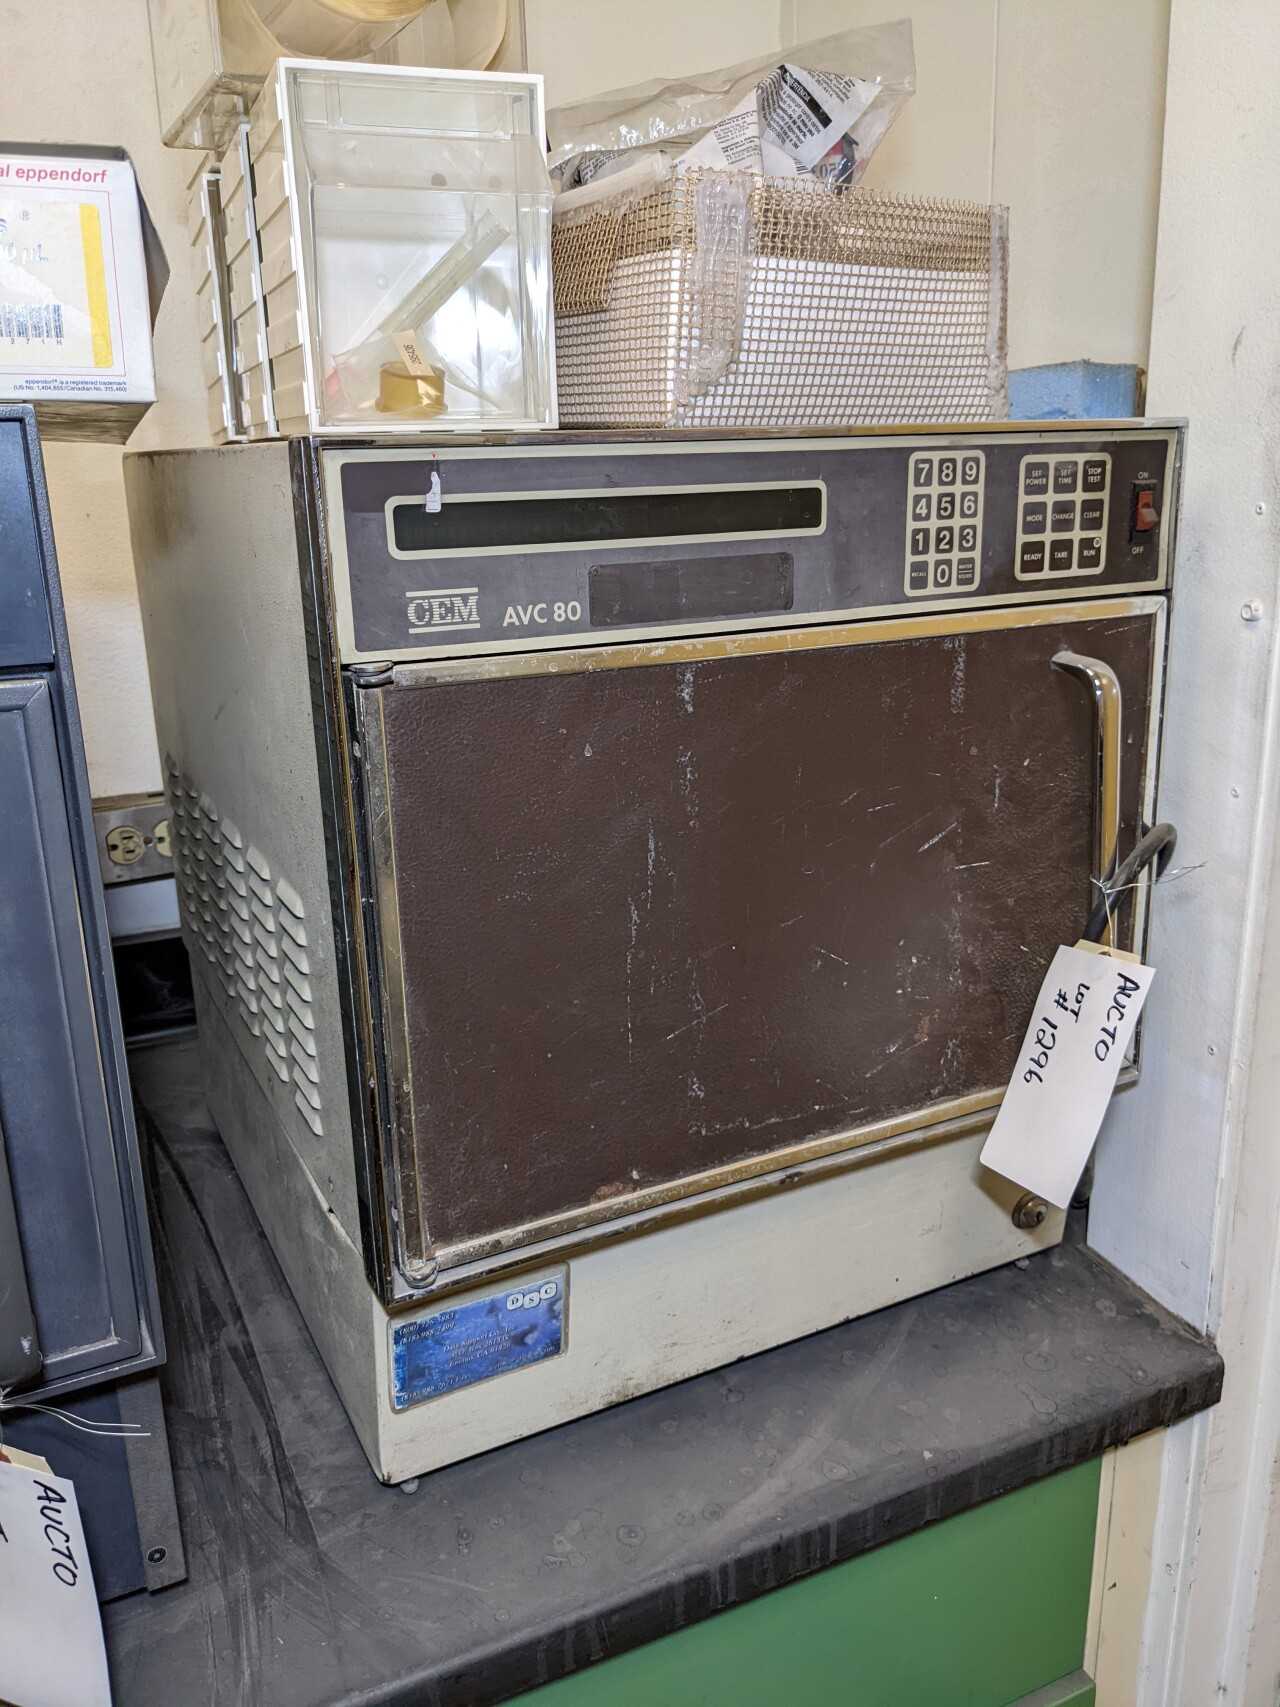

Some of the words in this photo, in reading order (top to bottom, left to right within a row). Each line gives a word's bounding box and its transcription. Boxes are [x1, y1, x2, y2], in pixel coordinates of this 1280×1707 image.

[16, 167, 107, 183] eppendorf
[918, 463, 929, 484] 7
[941, 462, 953, 482] 8
[965, 461, 977, 481] 9
[915, 498, 928, 518] 4
[940, 497, 952, 516] 5
[963, 495, 975, 514] 6
[915, 532, 924, 551] 1
[939, 531, 950, 549] 2
[962, 529, 973, 547] 3
[1132, 546, 1144, 555] OFF
[1024, 553, 1042, 561] READY
[1083, 549, 1096, 557] RUN
[936, 564, 950, 584] 0
[407, 594, 481, 626] CEM
[503, 602, 547, 627] AVC
[553, 600, 581, 623] 80
[1094, 972, 1141, 1062] AUCTO
[1023, 1016, 1059, 1085] 1296
[508, 1284, 554, 1308] DSC
[33, 1479, 79, 1587] AUCTO
